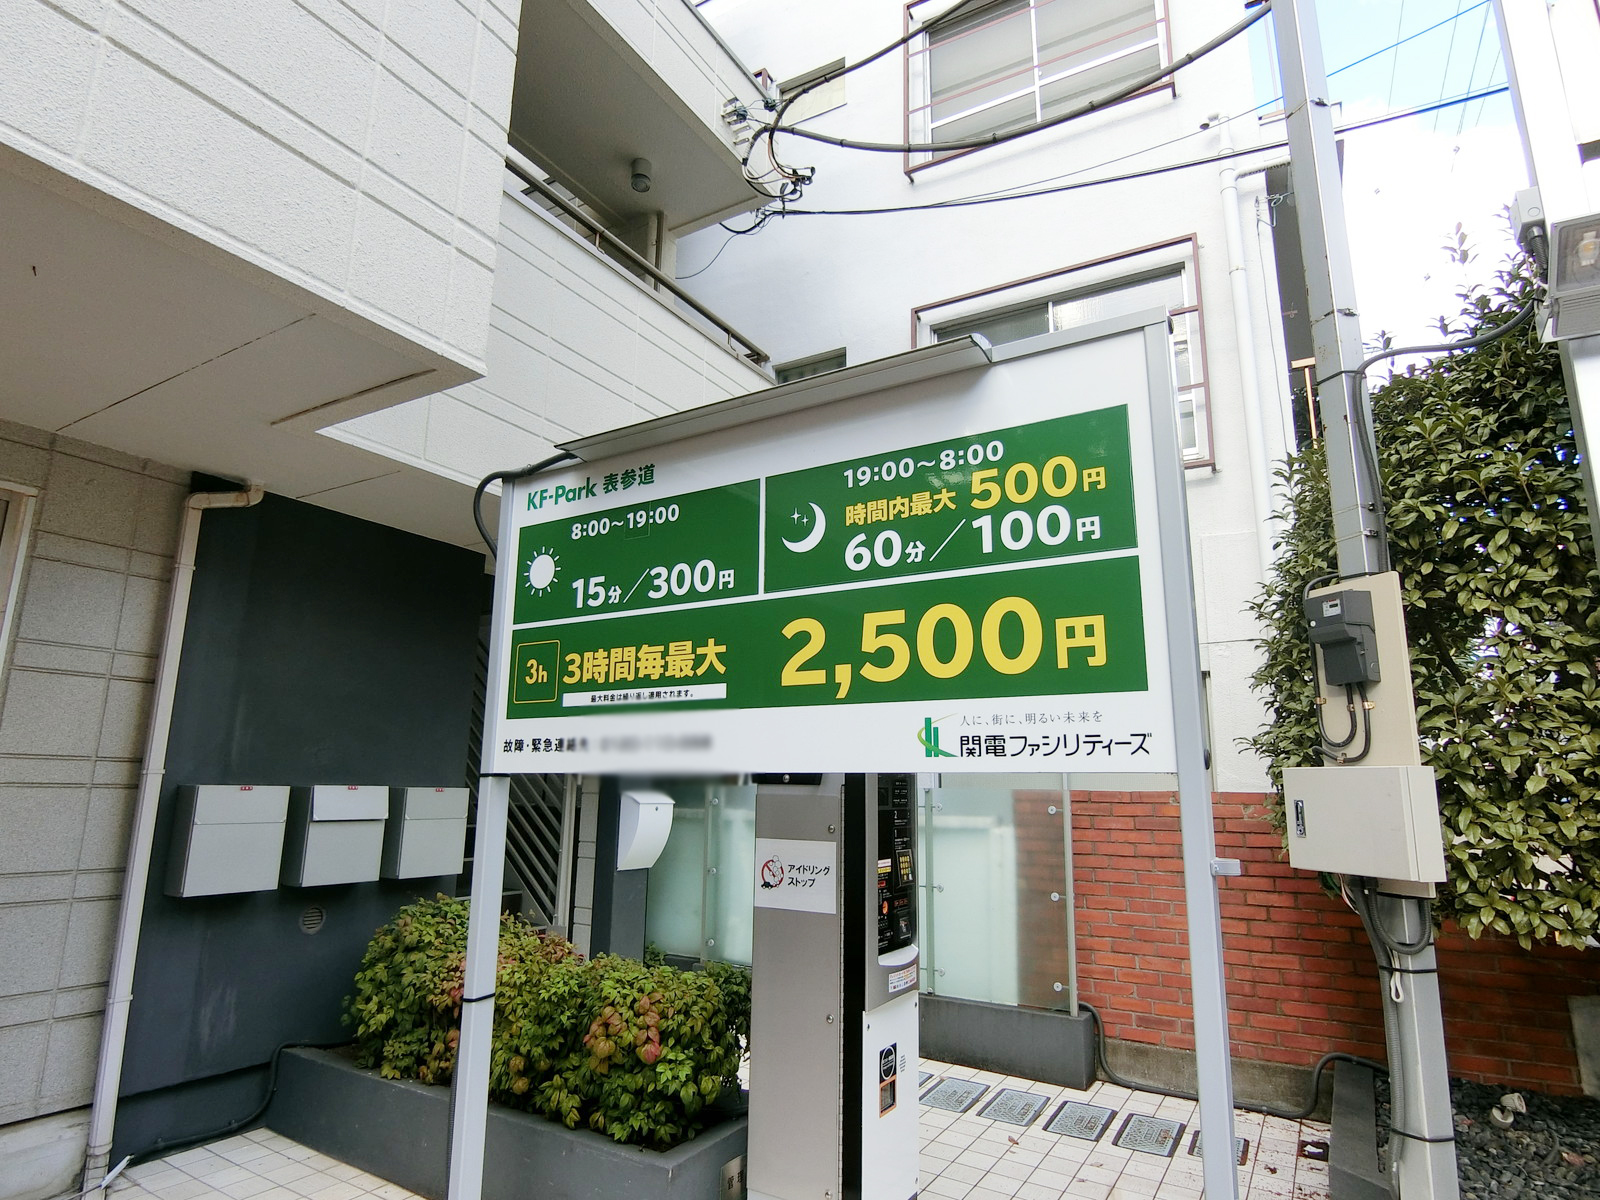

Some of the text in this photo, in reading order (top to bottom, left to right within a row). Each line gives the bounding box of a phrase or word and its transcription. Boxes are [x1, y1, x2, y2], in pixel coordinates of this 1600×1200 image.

[527, 463, 656, 511] KF-Park 表参道
[844, 455, 1106, 527] 時間内最大 500円
[562, 595, 1107, 699] 3時間毎最大 2,500円
[525, 658, 548, 685] 3h
[959, 711, 1103, 727] 人に、街に、明るい未来を
[959, 732, 1153, 759] 関電ファシリティーズ
[787, 863, 831, 878] アイドリング
[787, 876, 817, 888] ストップ
